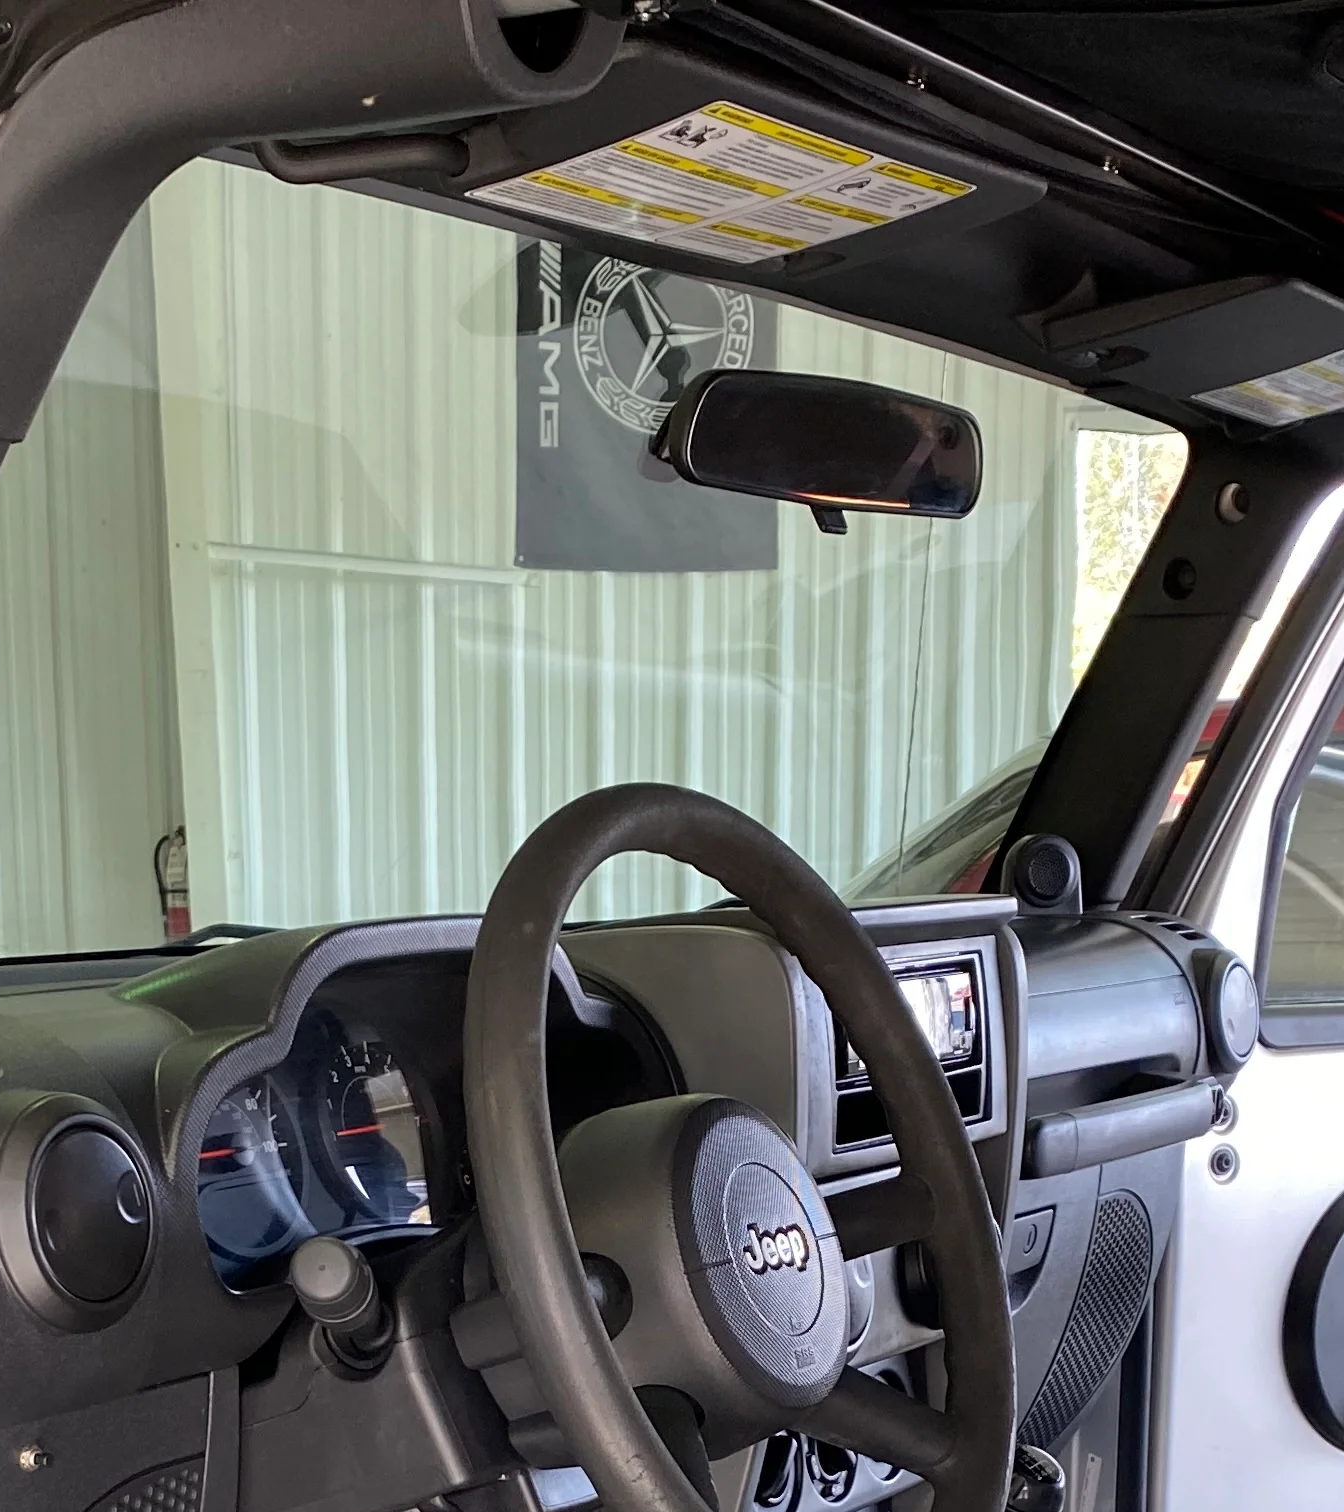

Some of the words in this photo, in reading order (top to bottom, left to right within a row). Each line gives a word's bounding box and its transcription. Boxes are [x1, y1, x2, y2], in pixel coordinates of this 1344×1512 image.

[578, 296, 604, 371] BENZ
[344, 1055, 353, 1068] 3
[364, 1053, 371, 1065] 4
[331, 1070, 340, 1083] 2
[244, 1098, 259, 1111] 80
[262, 1140, 279, 1153] 100
[463, 1174, 471, 1185] C
[743, 1223, 810, 1275] Jeep
